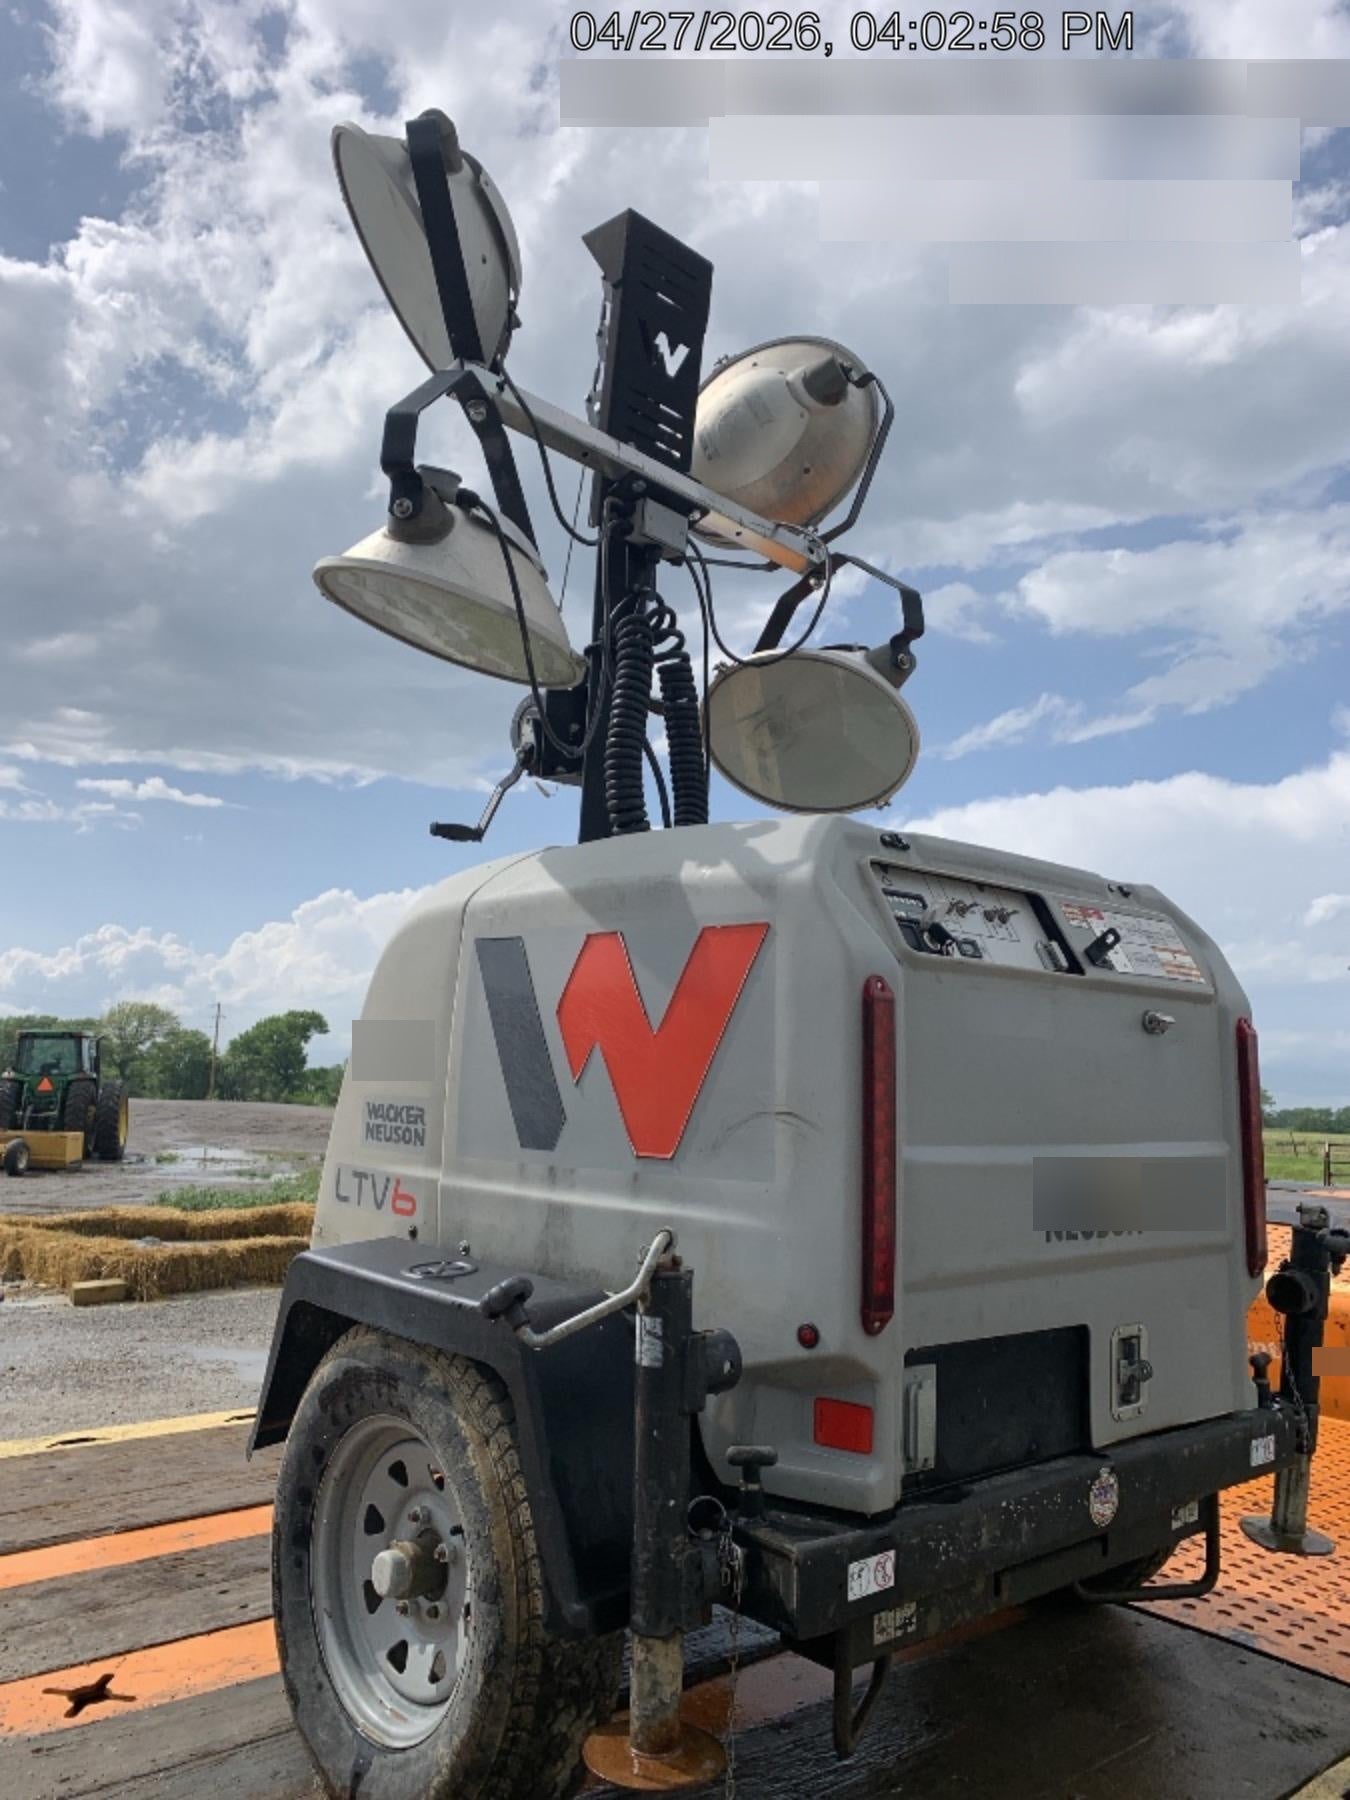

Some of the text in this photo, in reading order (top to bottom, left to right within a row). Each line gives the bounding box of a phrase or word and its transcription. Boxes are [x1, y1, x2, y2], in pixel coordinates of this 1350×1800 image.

[365, 1101, 427, 1127] WACKER
[365, 1122, 427, 1147] NEUSON
[335, 1167, 417, 1217] LTV6
